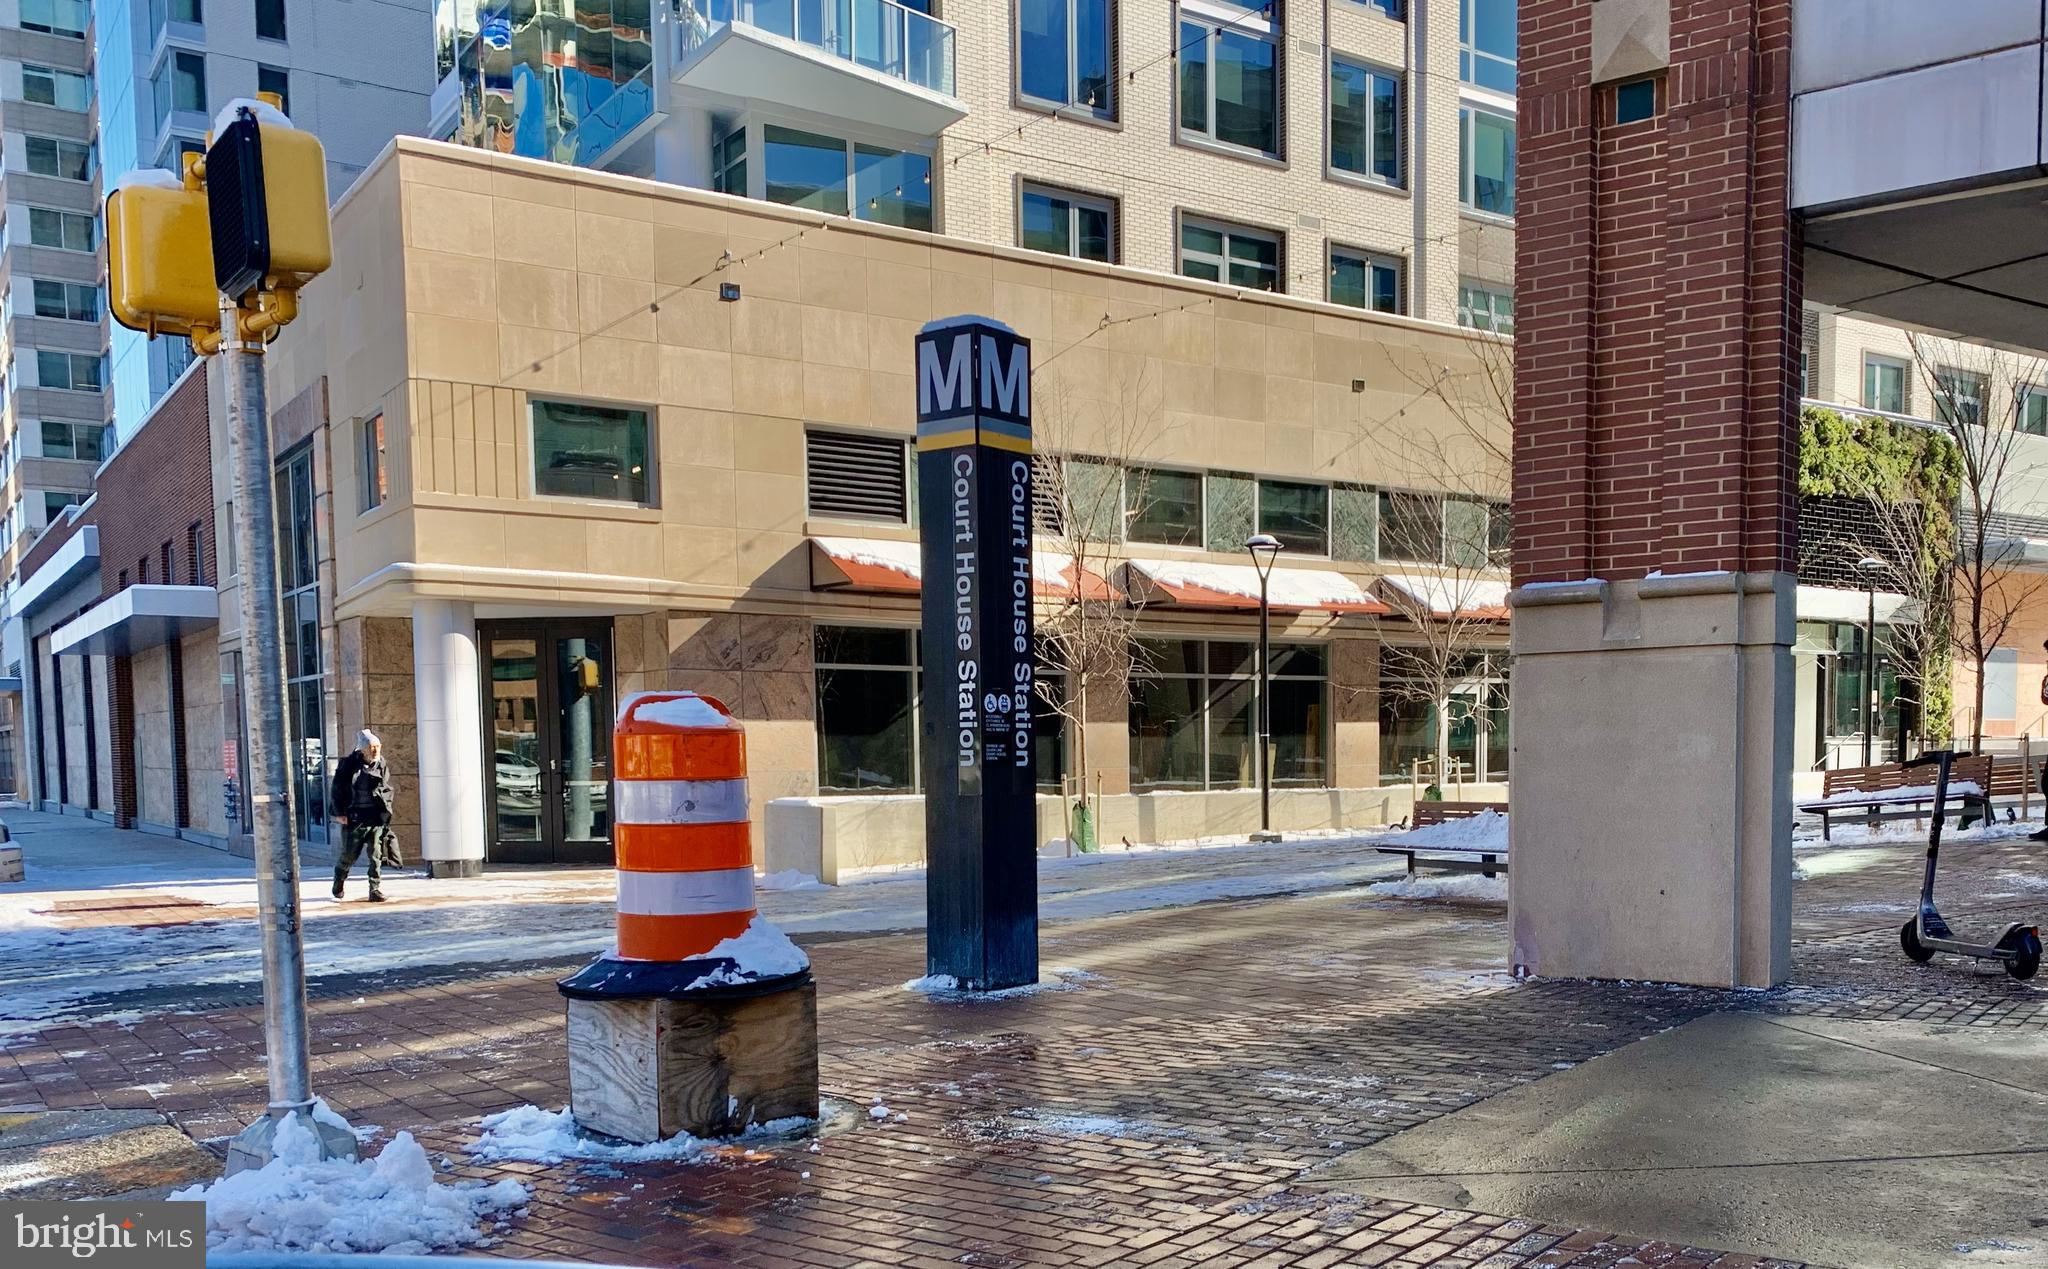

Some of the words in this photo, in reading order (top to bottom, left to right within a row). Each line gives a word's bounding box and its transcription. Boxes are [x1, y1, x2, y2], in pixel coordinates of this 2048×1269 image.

[919, 333, 973, 415] M
[980, 333, 1029, 418] M
[953, 454, 974, 544] Court
[1011, 460, 1029, 548] Court
[955, 552, 975, 651] House
[1013, 556, 1030, 653] House
[957, 660, 978, 767] Station
[1014, 662, 1032, 767] Station
